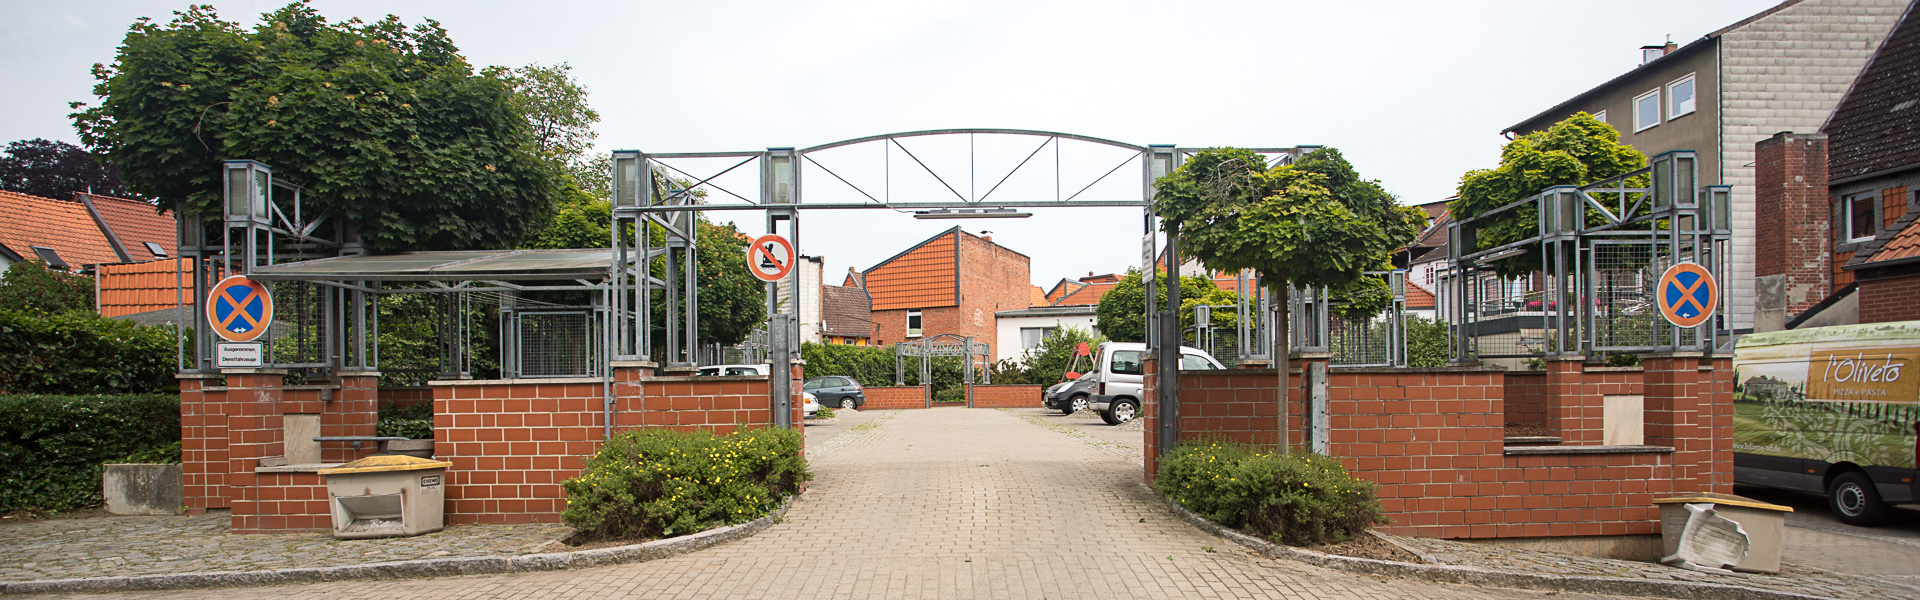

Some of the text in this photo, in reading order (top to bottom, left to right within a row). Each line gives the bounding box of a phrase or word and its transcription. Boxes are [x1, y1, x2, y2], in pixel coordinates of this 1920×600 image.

[1823, 352, 1905, 383] l'Oliveto
[1833, 388, 1854, 396] PIZZA
[1861, 388, 1887, 396] PASTA
